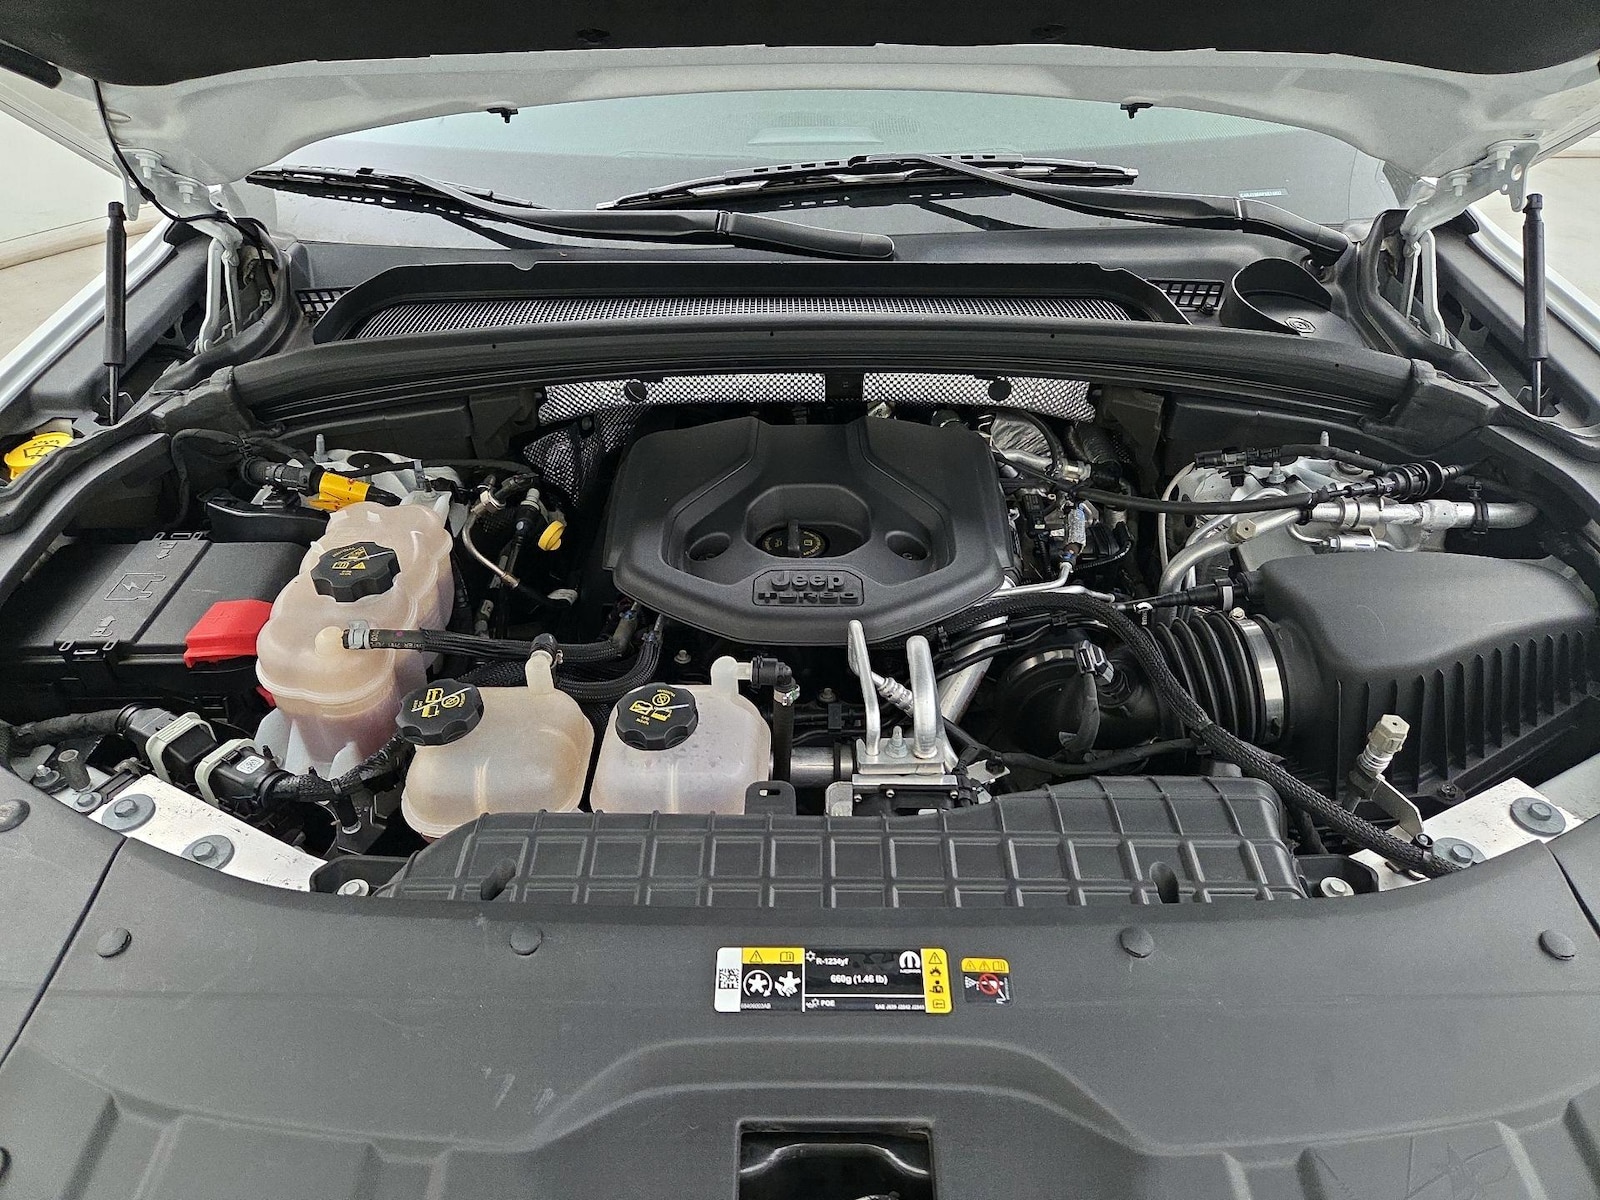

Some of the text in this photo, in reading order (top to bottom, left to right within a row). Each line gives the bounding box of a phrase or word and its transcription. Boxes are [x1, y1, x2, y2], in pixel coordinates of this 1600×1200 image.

[770, 571, 845, 592] Jeep
[815, 957, 849, 967] R-1234yf
[876, 974, 888, 985] lb)
